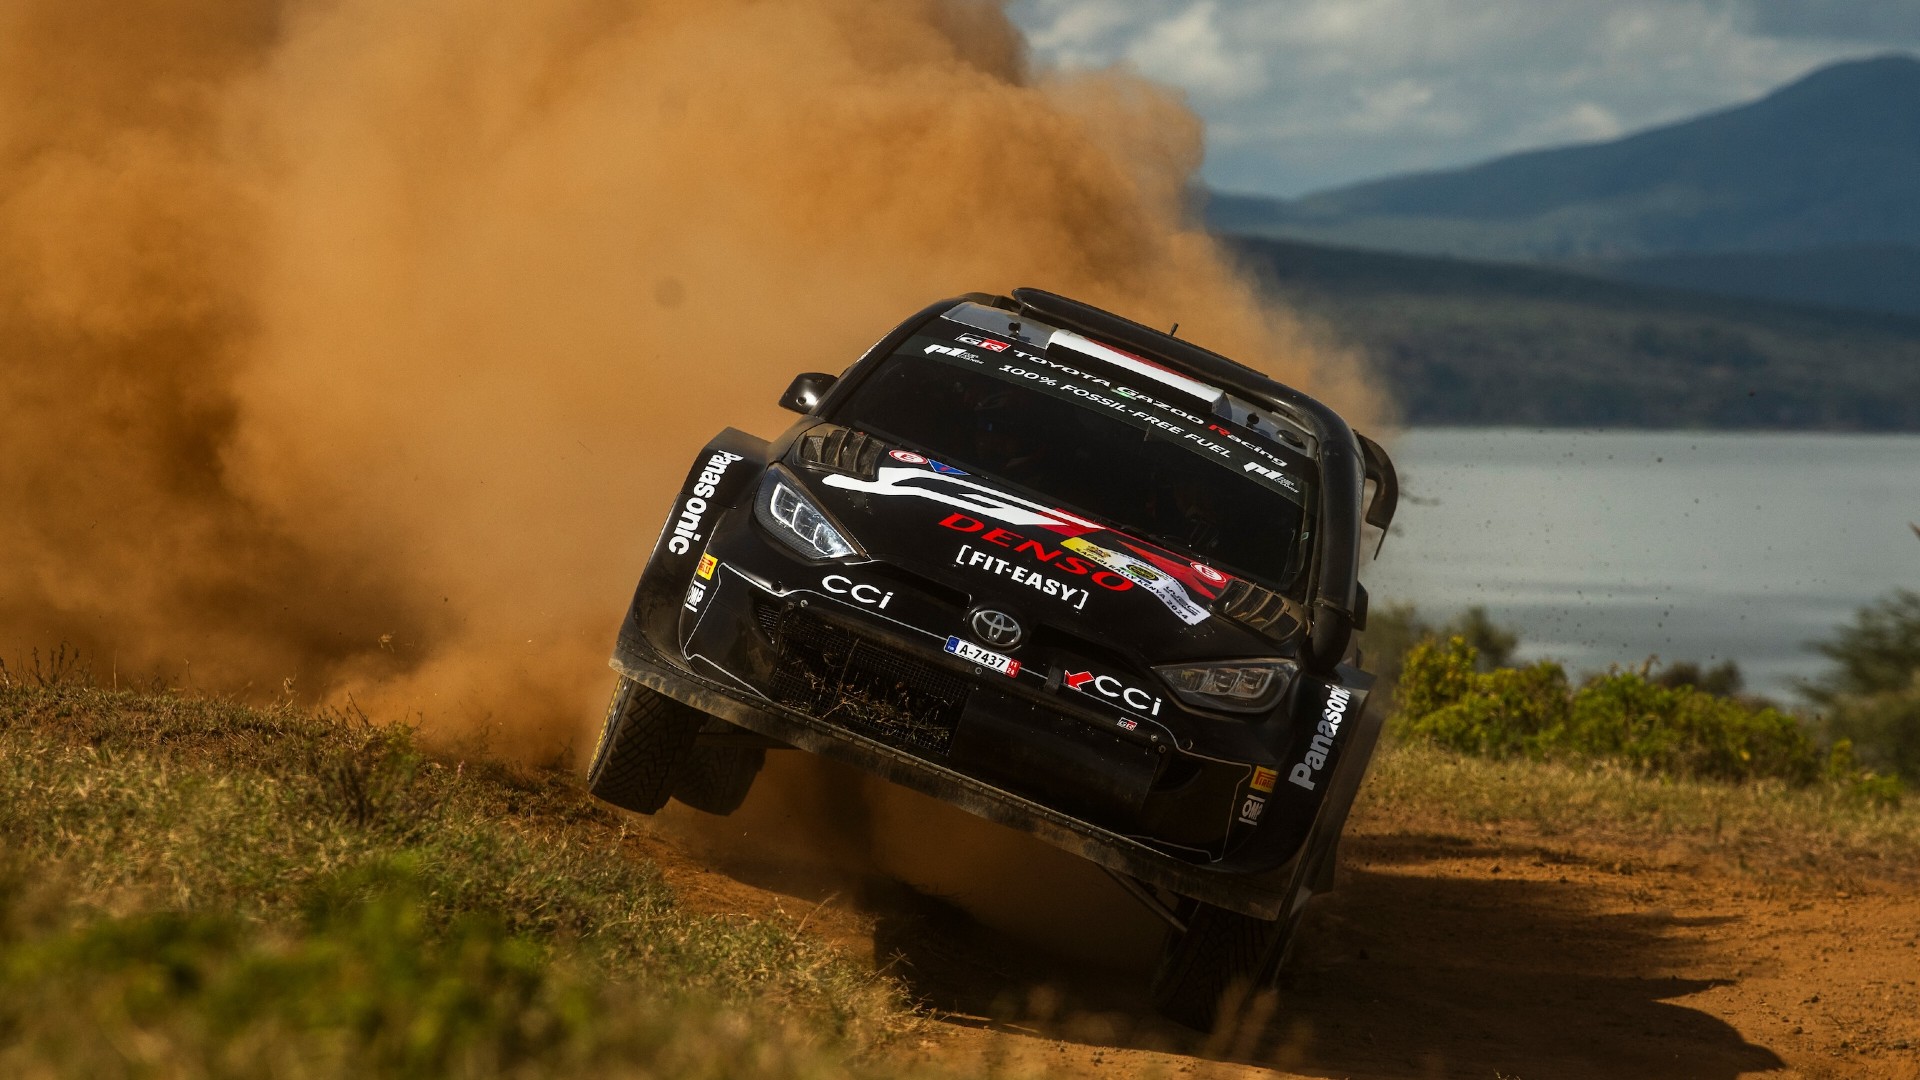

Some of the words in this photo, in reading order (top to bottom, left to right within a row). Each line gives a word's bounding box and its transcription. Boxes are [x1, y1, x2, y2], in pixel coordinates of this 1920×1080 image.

[998, 364, 1057, 386] 100%
[1060, 384, 1185, 434] FOSSIL-FREE
[1184, 433, 1230, 458] FUEL
[1014, 349, 1110, 387] TOYOTA
[1116, 386, 1204, 425] GAZOO
[1208, 424, 1287, 467] Racing
[669, 449, 744, 555] Panasonic
[938, 512, 1134, 592] DENSO
[1075, 547, 1107, 565] SAFARI
[1107, 565, 1137, 580] RALLY
[1138, 579, 1165, 601] KENYA
[1166, 599, 1189, 620] 2024
[960, 644, 1006, 669] A-7437
[1006, 667, 1015, 676] 24
[1241, 797, 1265, 822] OMP
